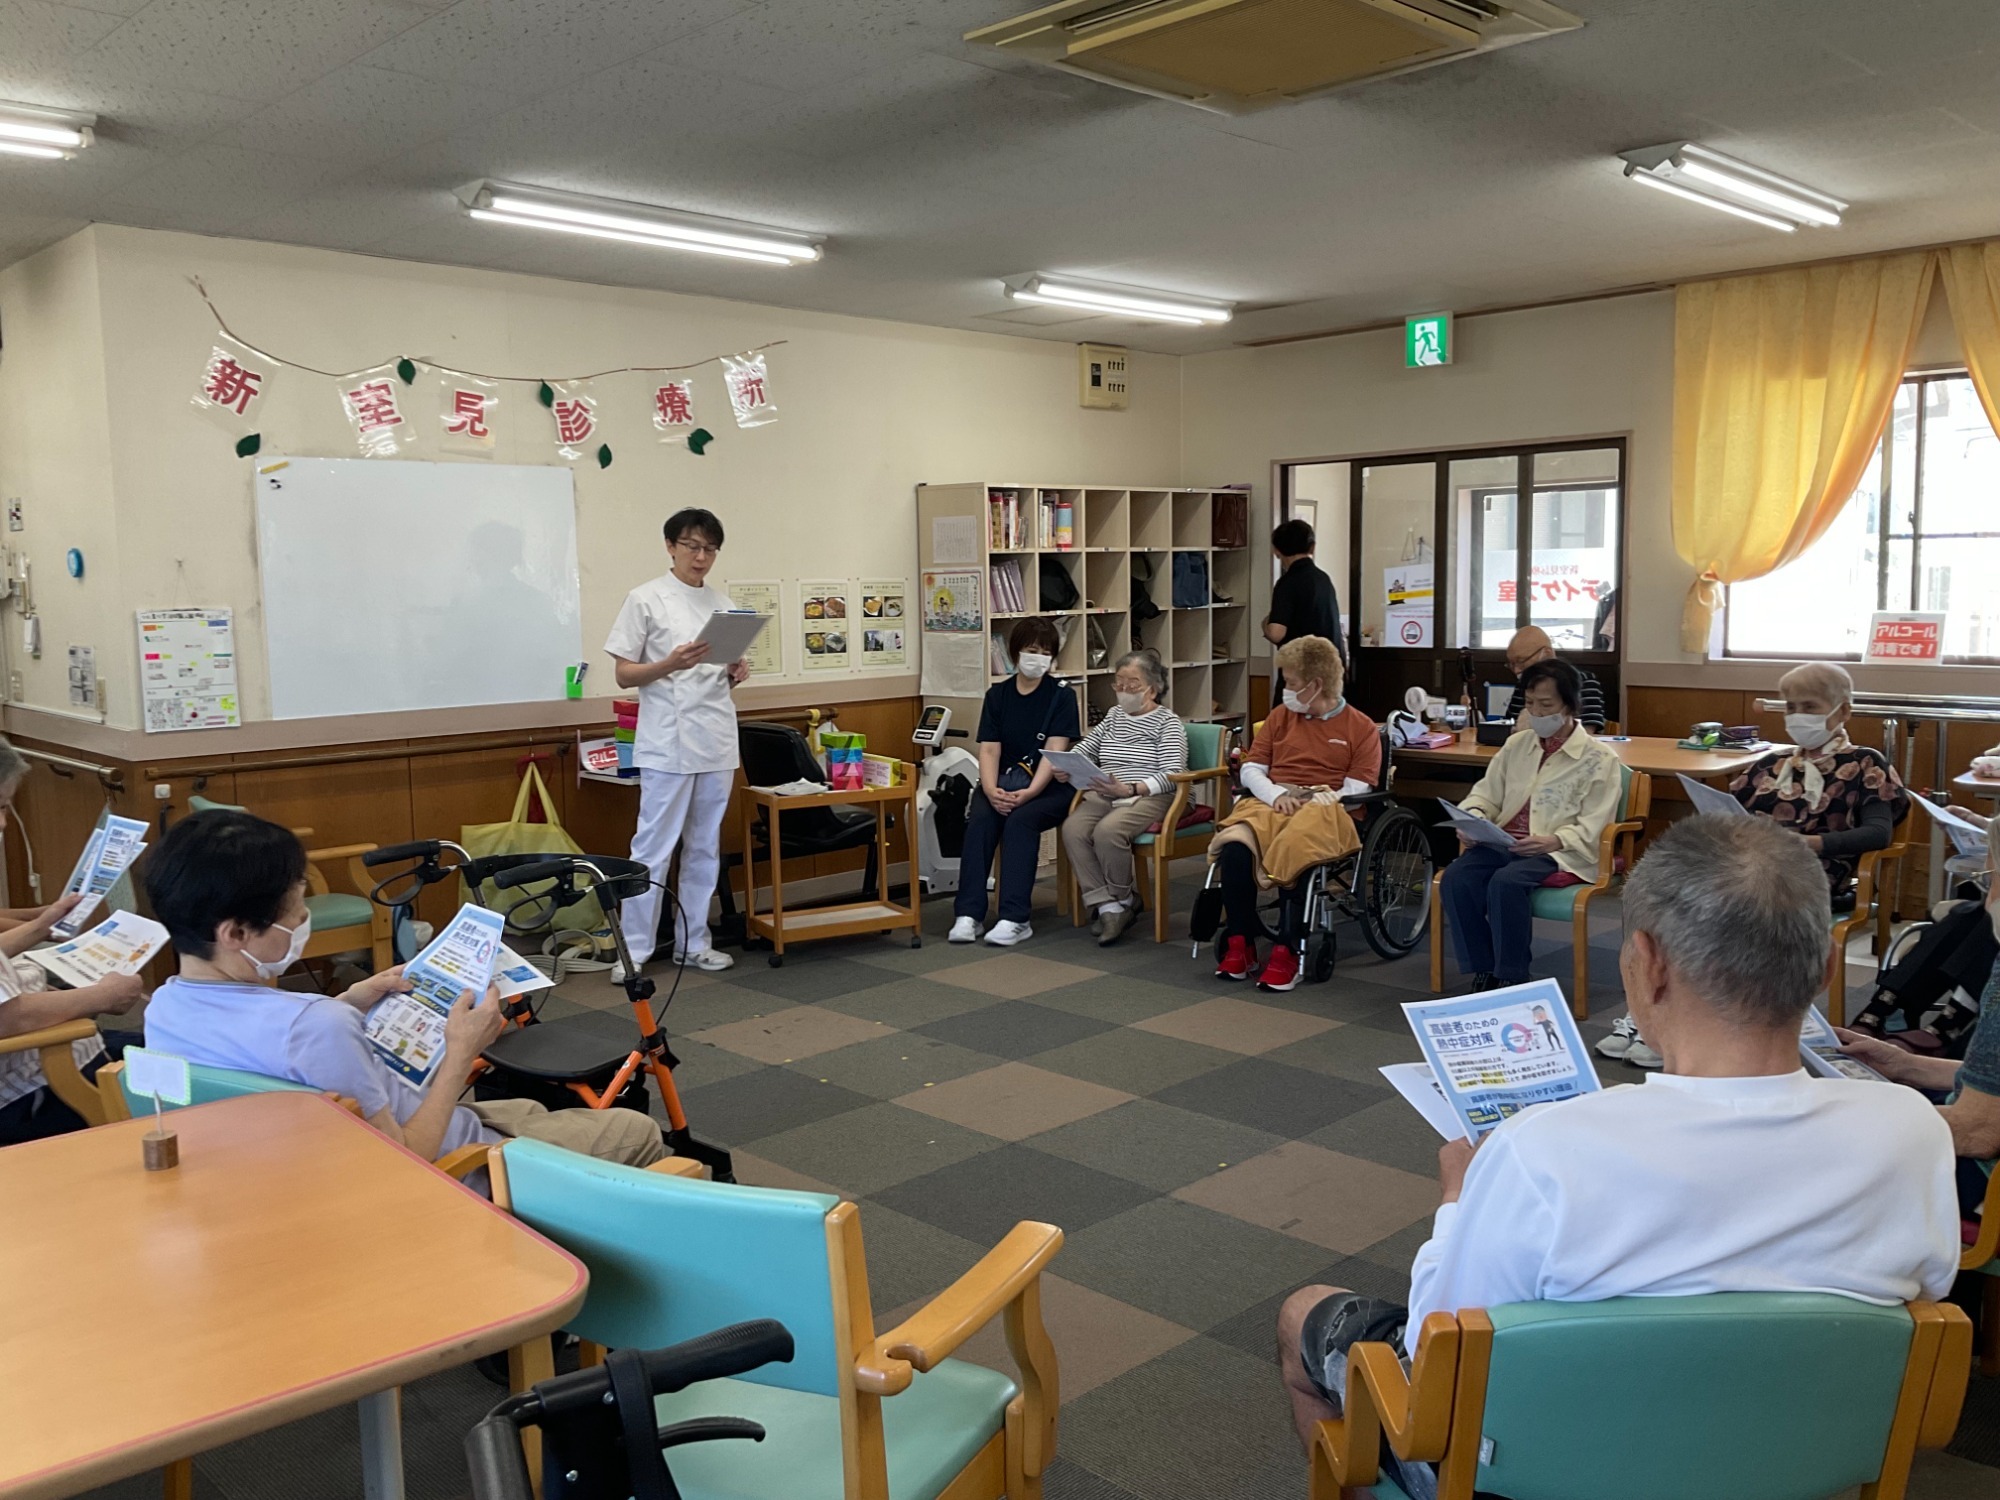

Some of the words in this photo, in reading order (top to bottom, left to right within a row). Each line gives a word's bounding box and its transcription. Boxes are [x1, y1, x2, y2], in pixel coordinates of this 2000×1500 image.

[1877, 625, 1937, 638] アルコール
[1429, 1018, 1499, 1035] 高齢者のための
[1436, 1032, 1494, 1050] 熱中症対策
